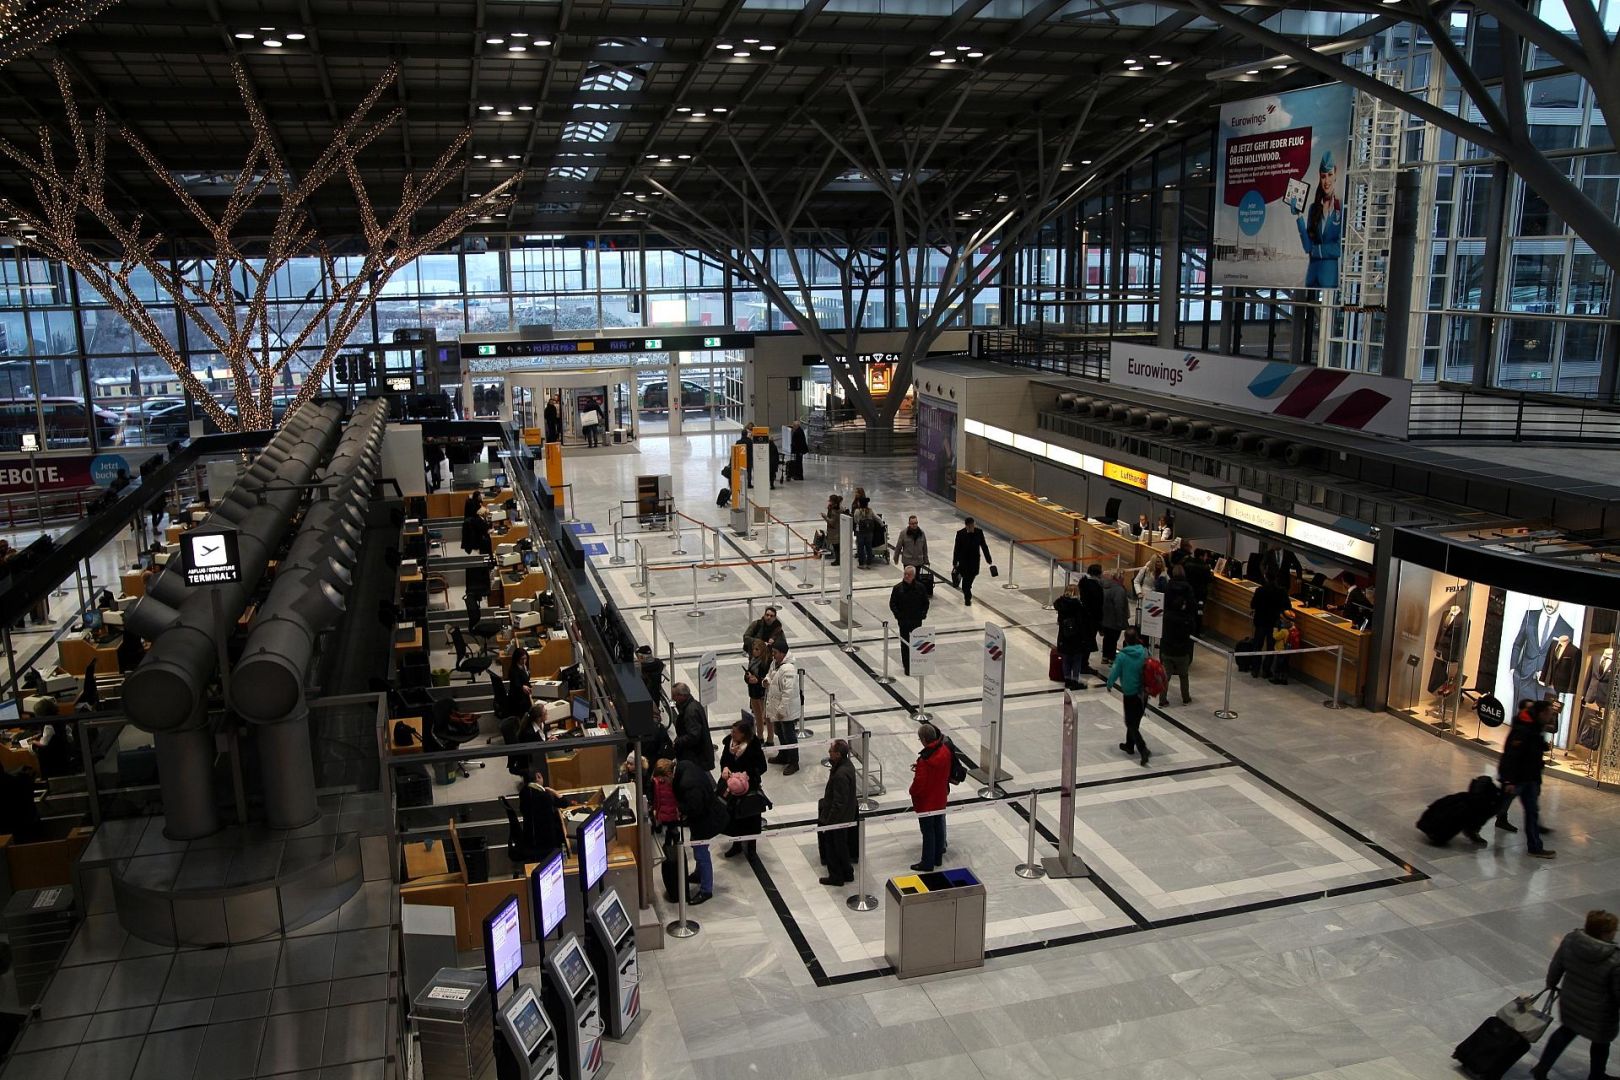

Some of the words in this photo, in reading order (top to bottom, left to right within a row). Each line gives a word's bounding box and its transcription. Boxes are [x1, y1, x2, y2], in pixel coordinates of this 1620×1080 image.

[1231, 113, 1266, 127] Eurowings
[1230, 145, 1238, 154] AB
[1238, 142, 1253, 153] JETZT
[1254, 140, 1268, 151] GEHT
[1269, 138, 1288, 149] JEDER
[1288, 136, 1304, 146] FLUG
[1230, 154, 1244, 166] ÜBER
[1244, 152, 1280, 164] HOLLYWOOD.
[1128, 358, 1183, 386] Eurowings
[100, 462, 119, 470] Jetzt
[1120, 470, 1146, 486] Lufthansa
[188, 572, 231, 583] TERMINAL
[1480, 703, 1501, 718] SALE
